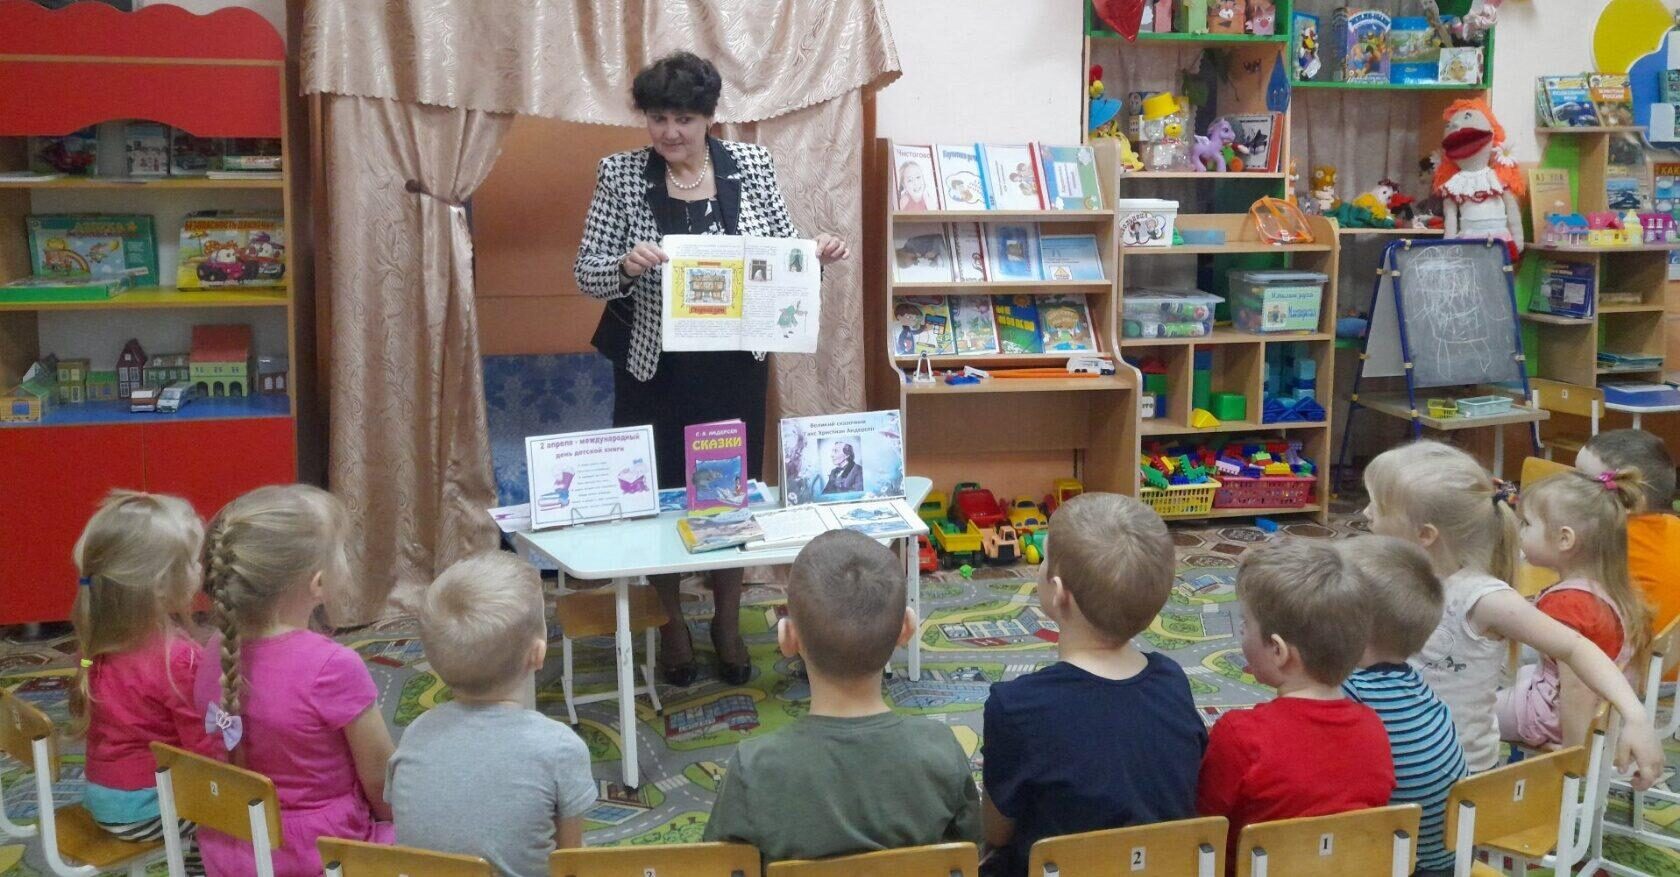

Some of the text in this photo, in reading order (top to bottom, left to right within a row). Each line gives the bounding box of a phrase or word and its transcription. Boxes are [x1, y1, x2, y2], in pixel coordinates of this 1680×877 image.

[540, 442, 545, 450] 2
[546, 439, 573, 449] апреля
[579, 433, 640, 445] международный
[692, 436, 742, 451] СКАЗКИ
[555, 451, 573, 460] день
[574, 447, 603, 457] детской
[1517, 784, 1521, 796] 1
[1323, 837, 1328, 850] 1
[1133, 851, 1142, 865] 2
